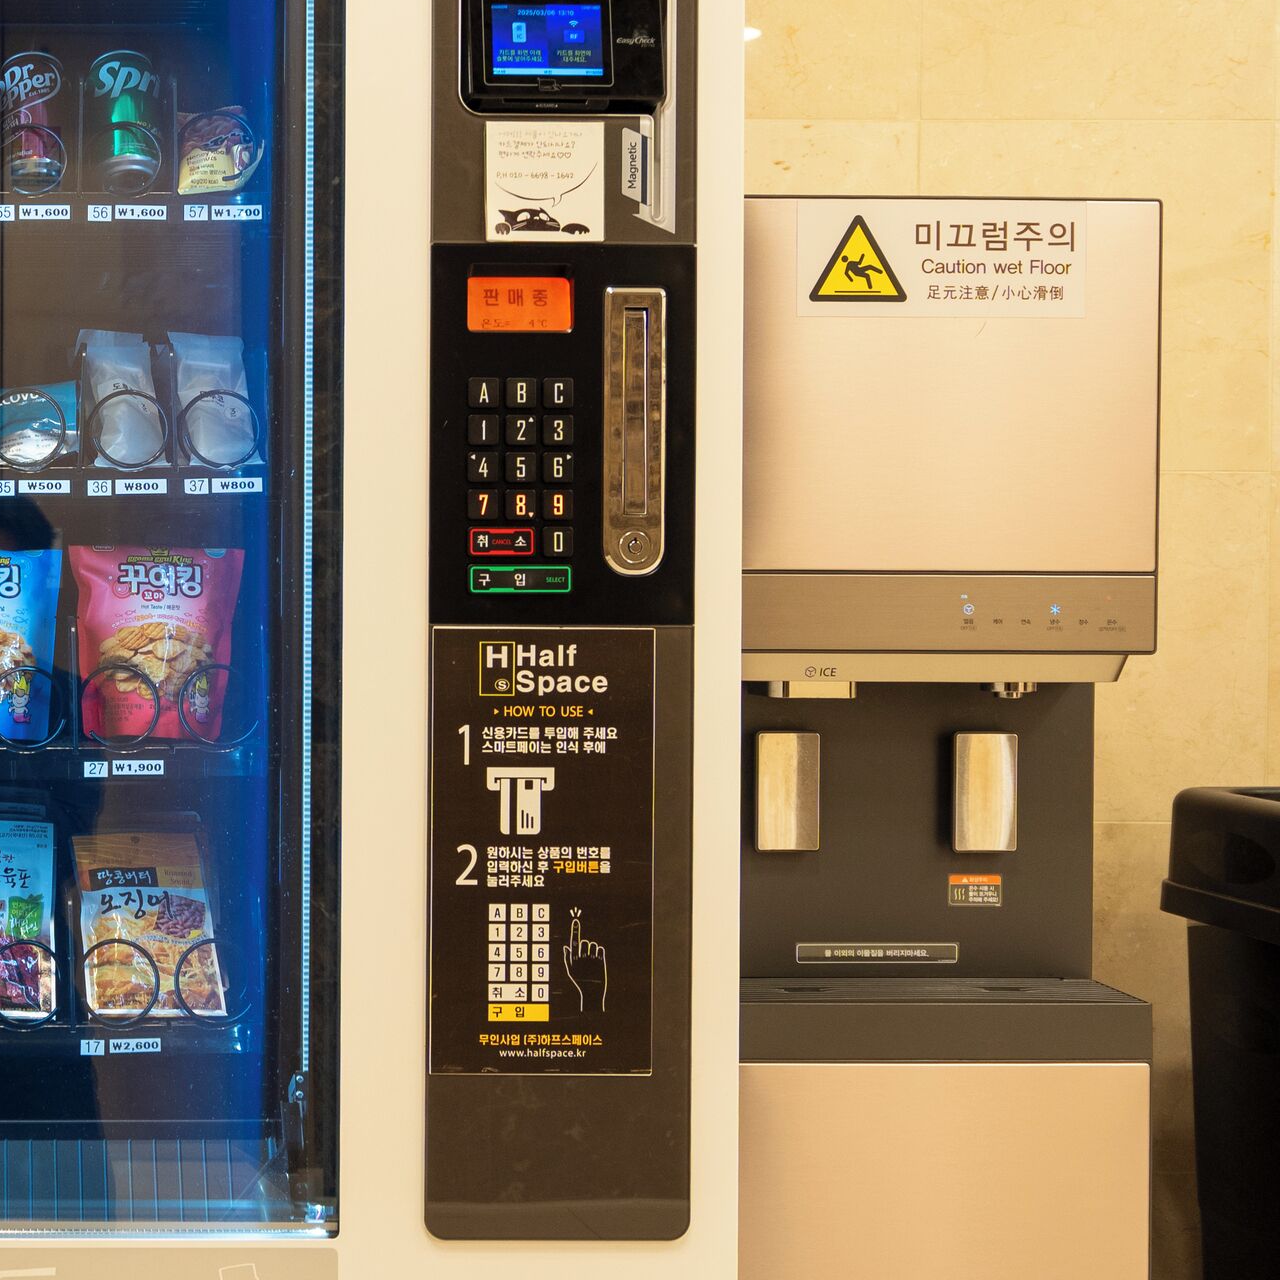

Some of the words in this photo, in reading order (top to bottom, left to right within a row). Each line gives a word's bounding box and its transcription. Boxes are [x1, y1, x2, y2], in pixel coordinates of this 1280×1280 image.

[616, 36, 655, 45] EasyCheck
[5, 63, 34, 88] Dr
[628, 141, 637, 190] Magnetic
[188, 205, 205, 218] 57
[915, 221, 1076, 252] 미끄럼주의
[922, 259, 986, 275] Caution
[994, 260, 1023, 274] wet
[1030, 260, 1072, 275] Floor
[927, 285, 1064, 302] 足元注意/小心滑倒
[189, 480, 205, 492] 37
[119, 564, 203, 598] 꾸이킹
[517, 644, 577, 667] Half
[819, 667, 837, 677] ICE
[516, 670, 608, 696] Space
[504, 706, 534, 717] HOW
[540, 706, 555, 717] TO
[561, 706, 583, 717] USE
[482, 727, 540, 739] 신용카드를
[544, 727, 579, 739] 투입해
[583, 727, 617, 739] 주세요
[482, 741, 551, 753] 스마트페이는
[556, 741, 578, 753] 인식
[583, 741, 606, 753] 후에
[89, 762, 105, 775] 27
[455, 844, 478, 886] 2
[487, 847, 533, 859] 원하시는
[538, 847, 572, 859] 상품의
[577, 847, 611, 859] 번호를
[487, 861, 533, 873] 입력하신
[538, 861, 548, 873] 후
[553, 861, 611, 873] 구입버튼을
[0, 867, 32, 889] 육포
[96, 868, 152, 887] 땅콩버터
[487, 875, 544, 887] 눌러주세요
[100, 889, 176, 920] 오징어
[85, 1040, 101, 1054] 17
[479, 1034, 520, 1045] 무인사업
[524, 1034, 602, 1046] (주)하프스페이스
[499, 1048, 586, 1059] www.halfspace.kr
